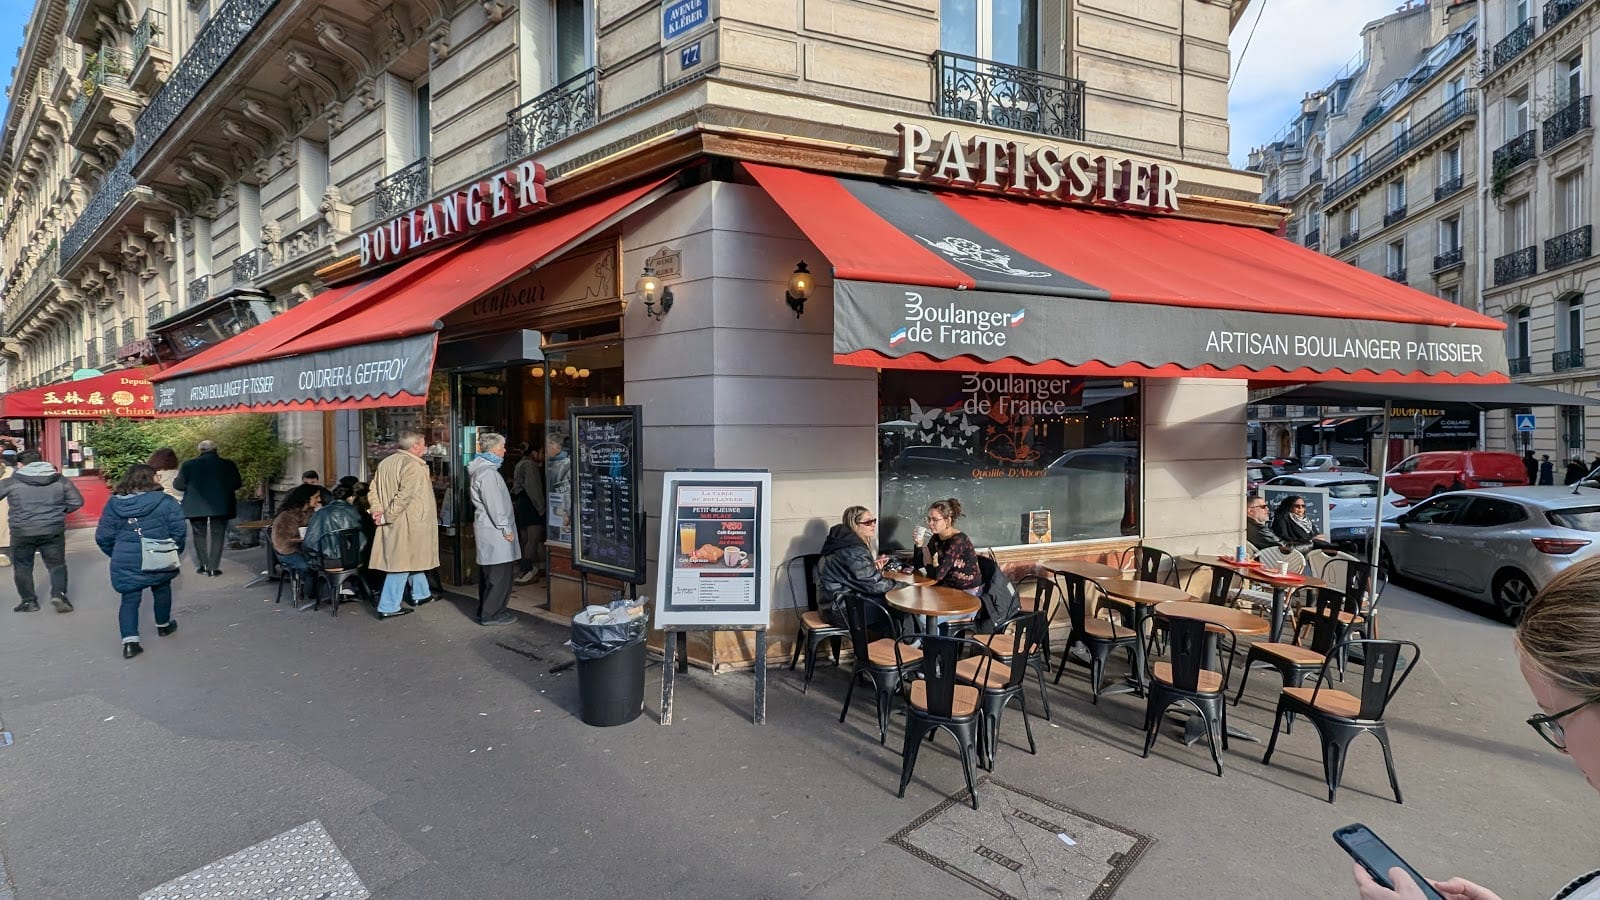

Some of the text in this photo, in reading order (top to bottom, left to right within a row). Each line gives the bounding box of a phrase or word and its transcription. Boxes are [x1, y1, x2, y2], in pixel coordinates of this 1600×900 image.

[670, 0, 702, 21] AVENUE
[683, 44, 699, 65] 77
[897, 122, 1180, 211] PATISSIER
[359, 160, 540, 267] BOULANGER
[905, 291, 1011, 330] Boulanger
[907, 321, 1007, 346] de France
[1205, 330, 1484, 363] ARTISAN BOULANGER PATISSIER
[242, 375, 274, 394] PTISSIER
[299, 366, 346, 391] COUDRIER
[355, 357, 409, 385] GEFFROY
[115, 406, 155, 415] Chinoi
[964, 392, 1066, 415] de France
